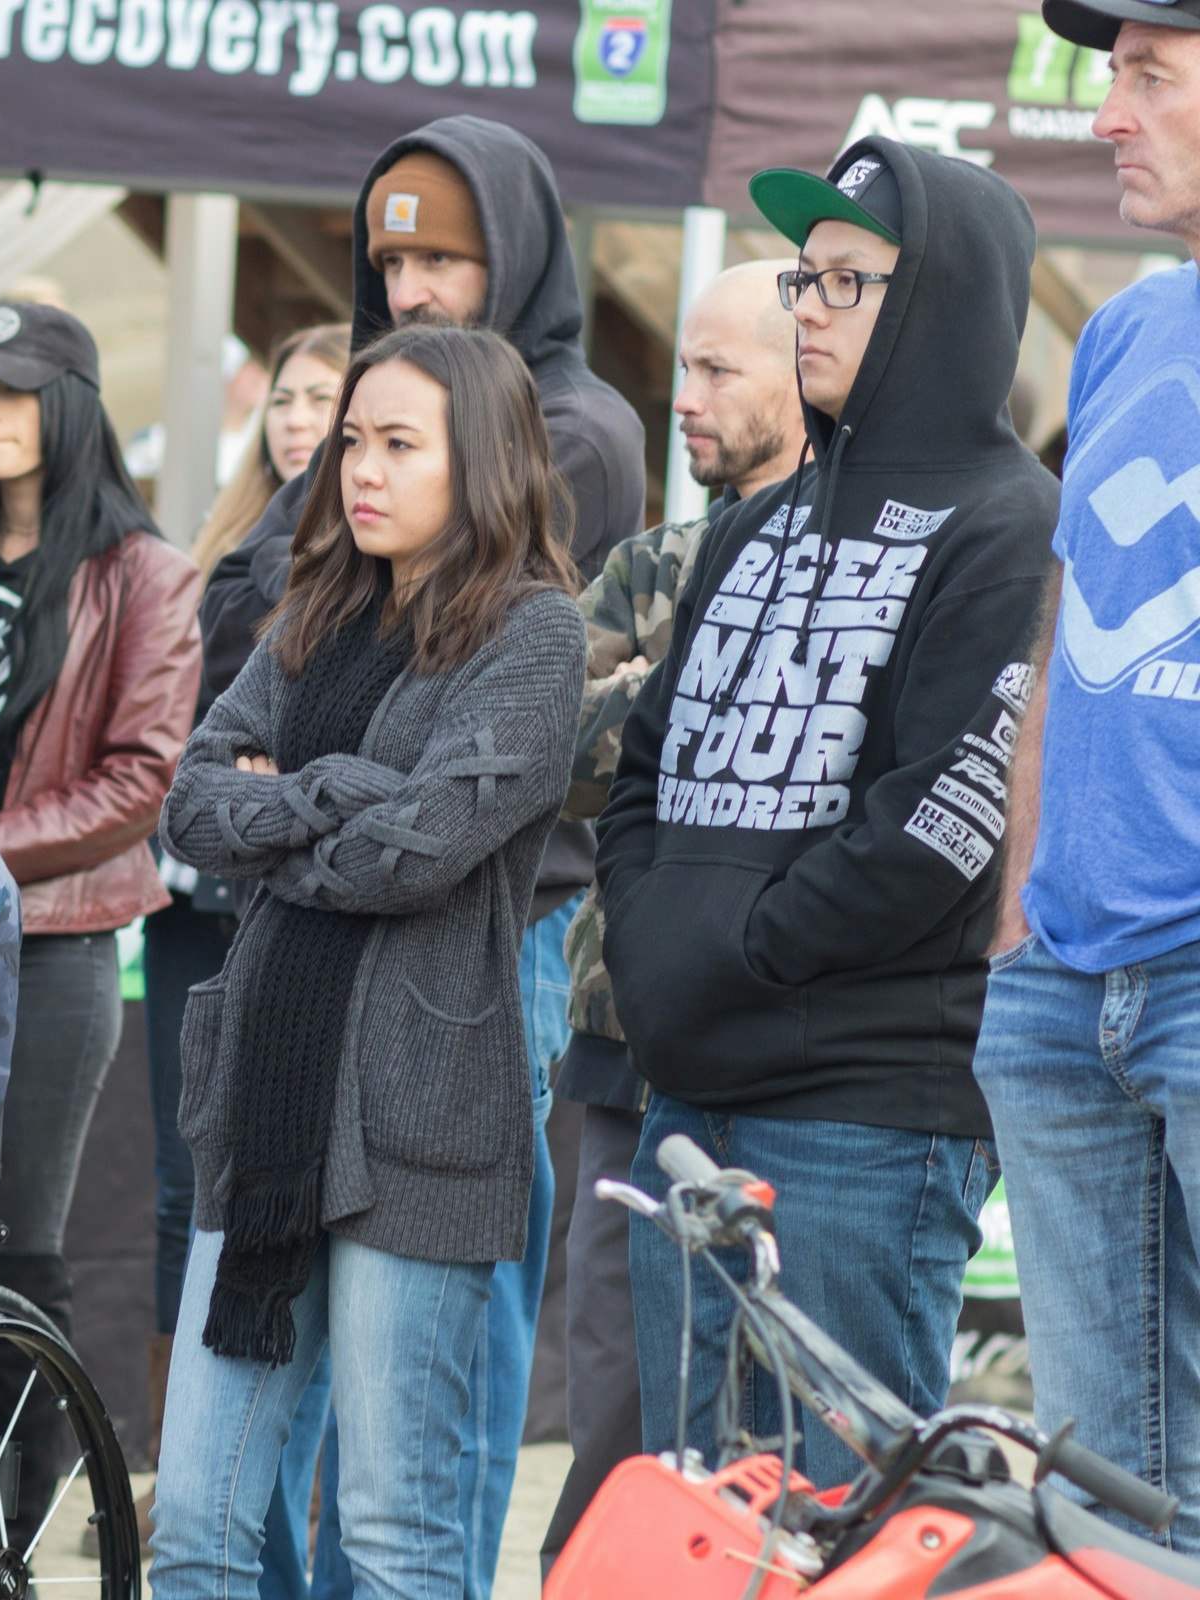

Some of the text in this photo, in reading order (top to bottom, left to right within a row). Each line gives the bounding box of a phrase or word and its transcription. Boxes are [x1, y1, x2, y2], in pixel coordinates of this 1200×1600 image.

[886, 505, 933, 523] BEST
[718, 533, 928, 599] RACER
[676, 623, 896, 705] MINT
[660, 695, 868, 782] FOUR
[963, 733, 1010, 768] GENERA
[657, 774, 850, 830] HUNDRED
[920, 803, 976, 843] BEST
[912, 815, 983, 871] DESERT
